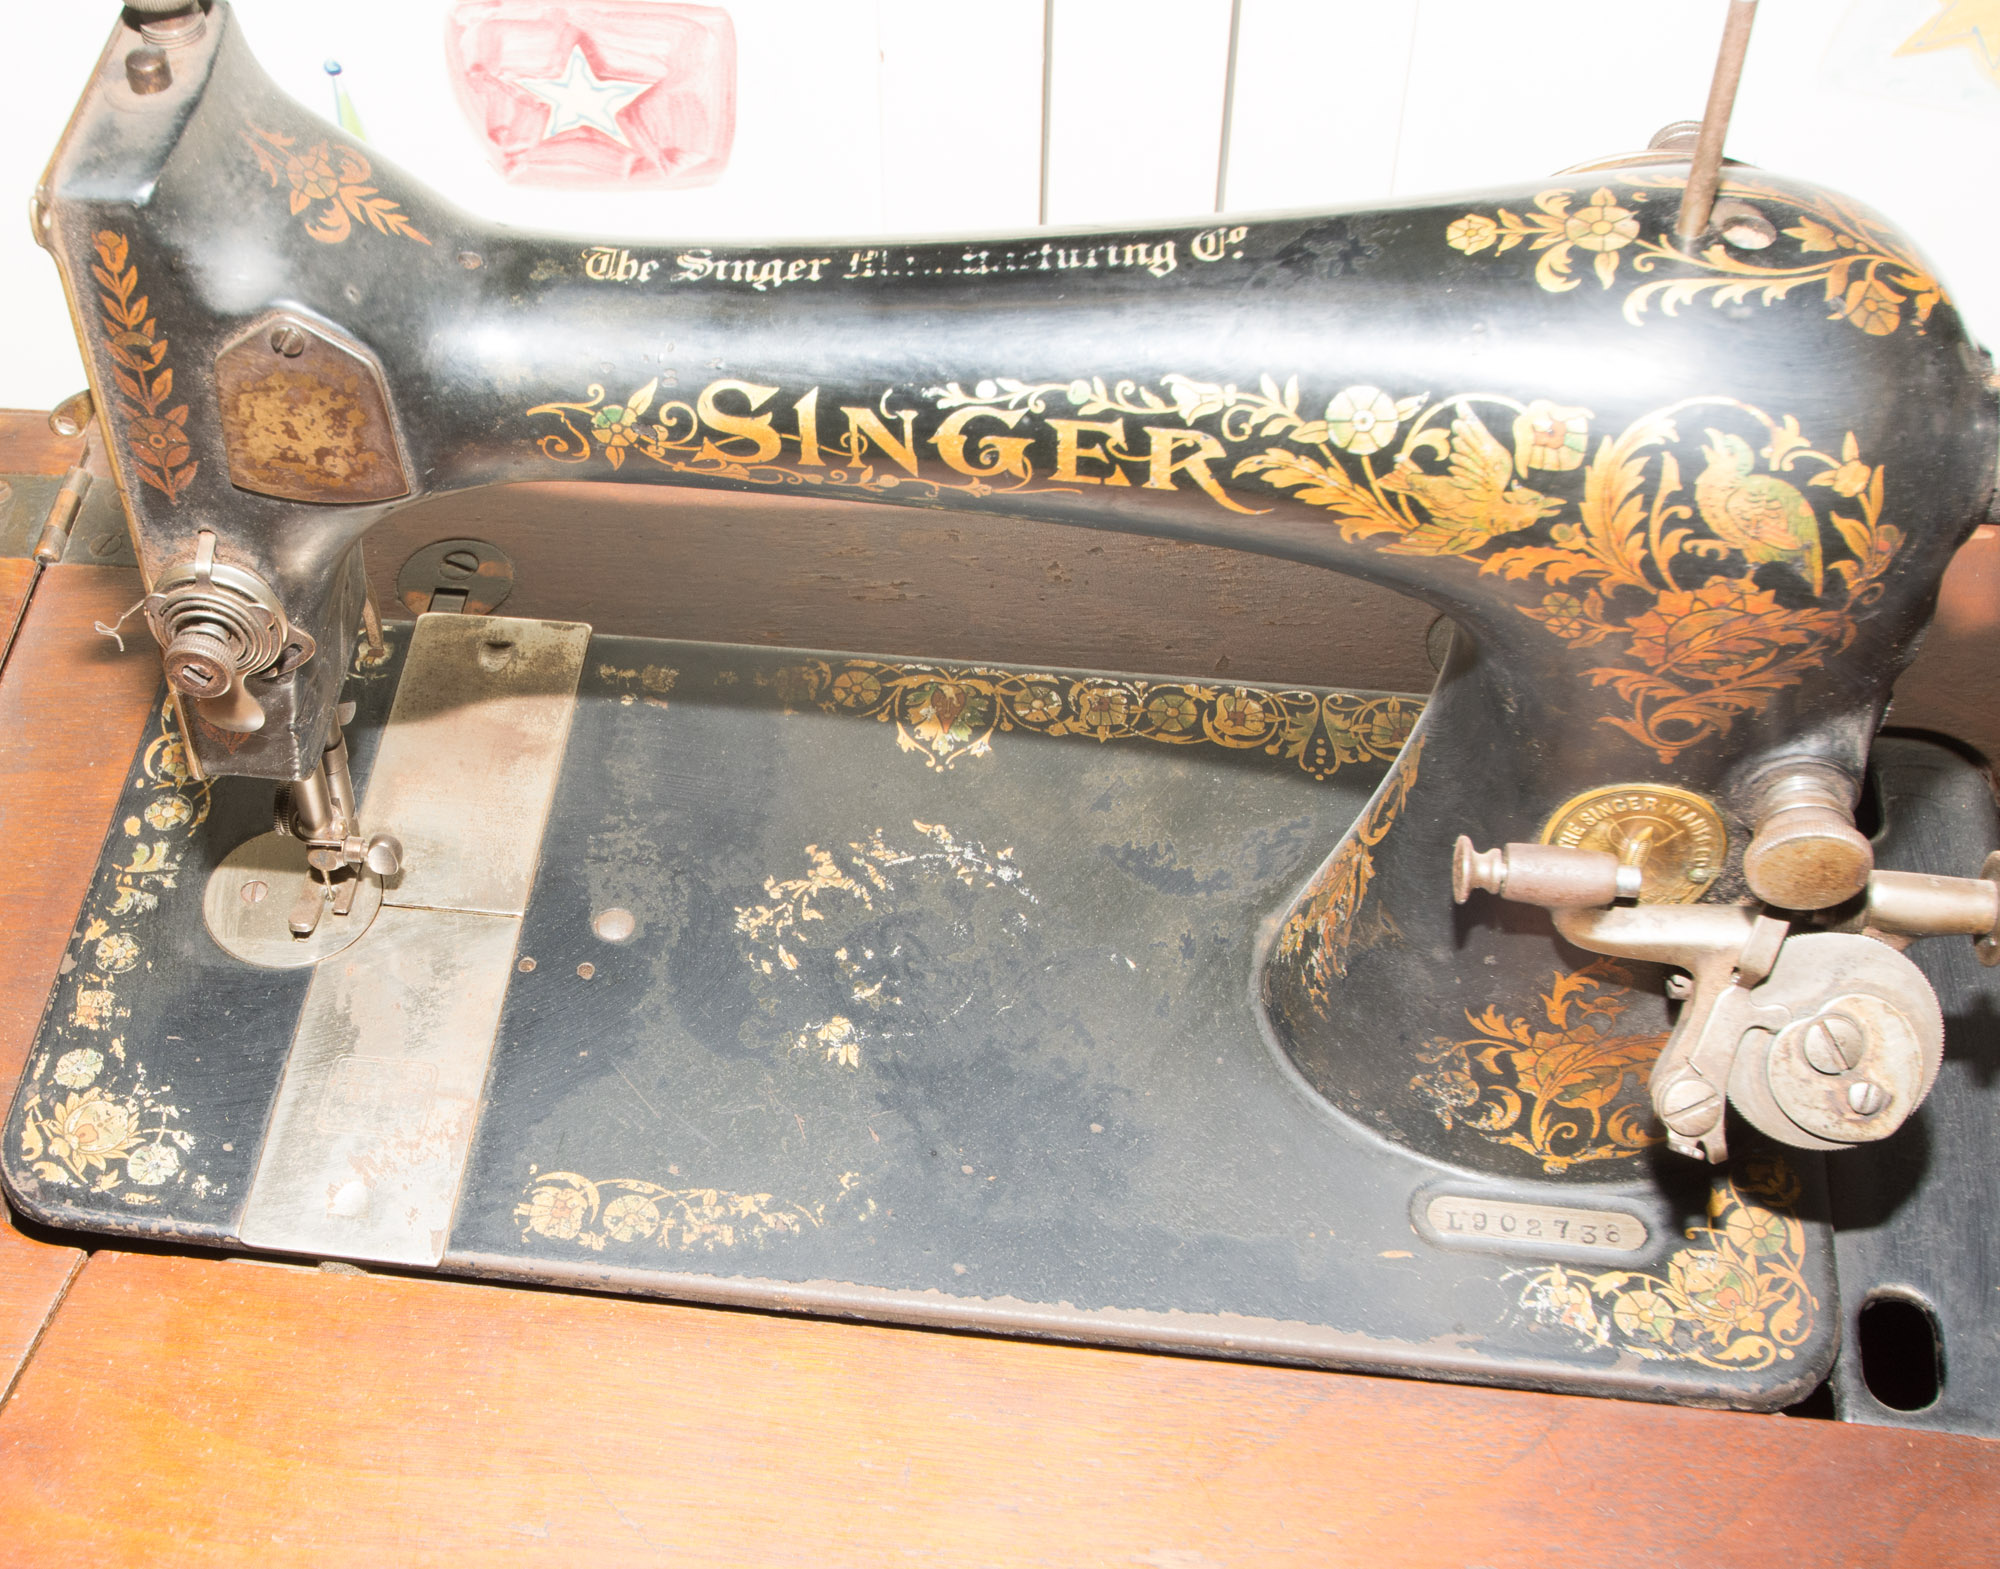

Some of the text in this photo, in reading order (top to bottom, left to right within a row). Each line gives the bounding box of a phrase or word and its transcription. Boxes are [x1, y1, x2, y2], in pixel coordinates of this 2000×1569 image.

[581, 246, 660, 283] The
[670, 248, 832, 291] Singer
[698, 379, 1274, 514] SINGER
[1579, 796, 1659, 826] SINGER
